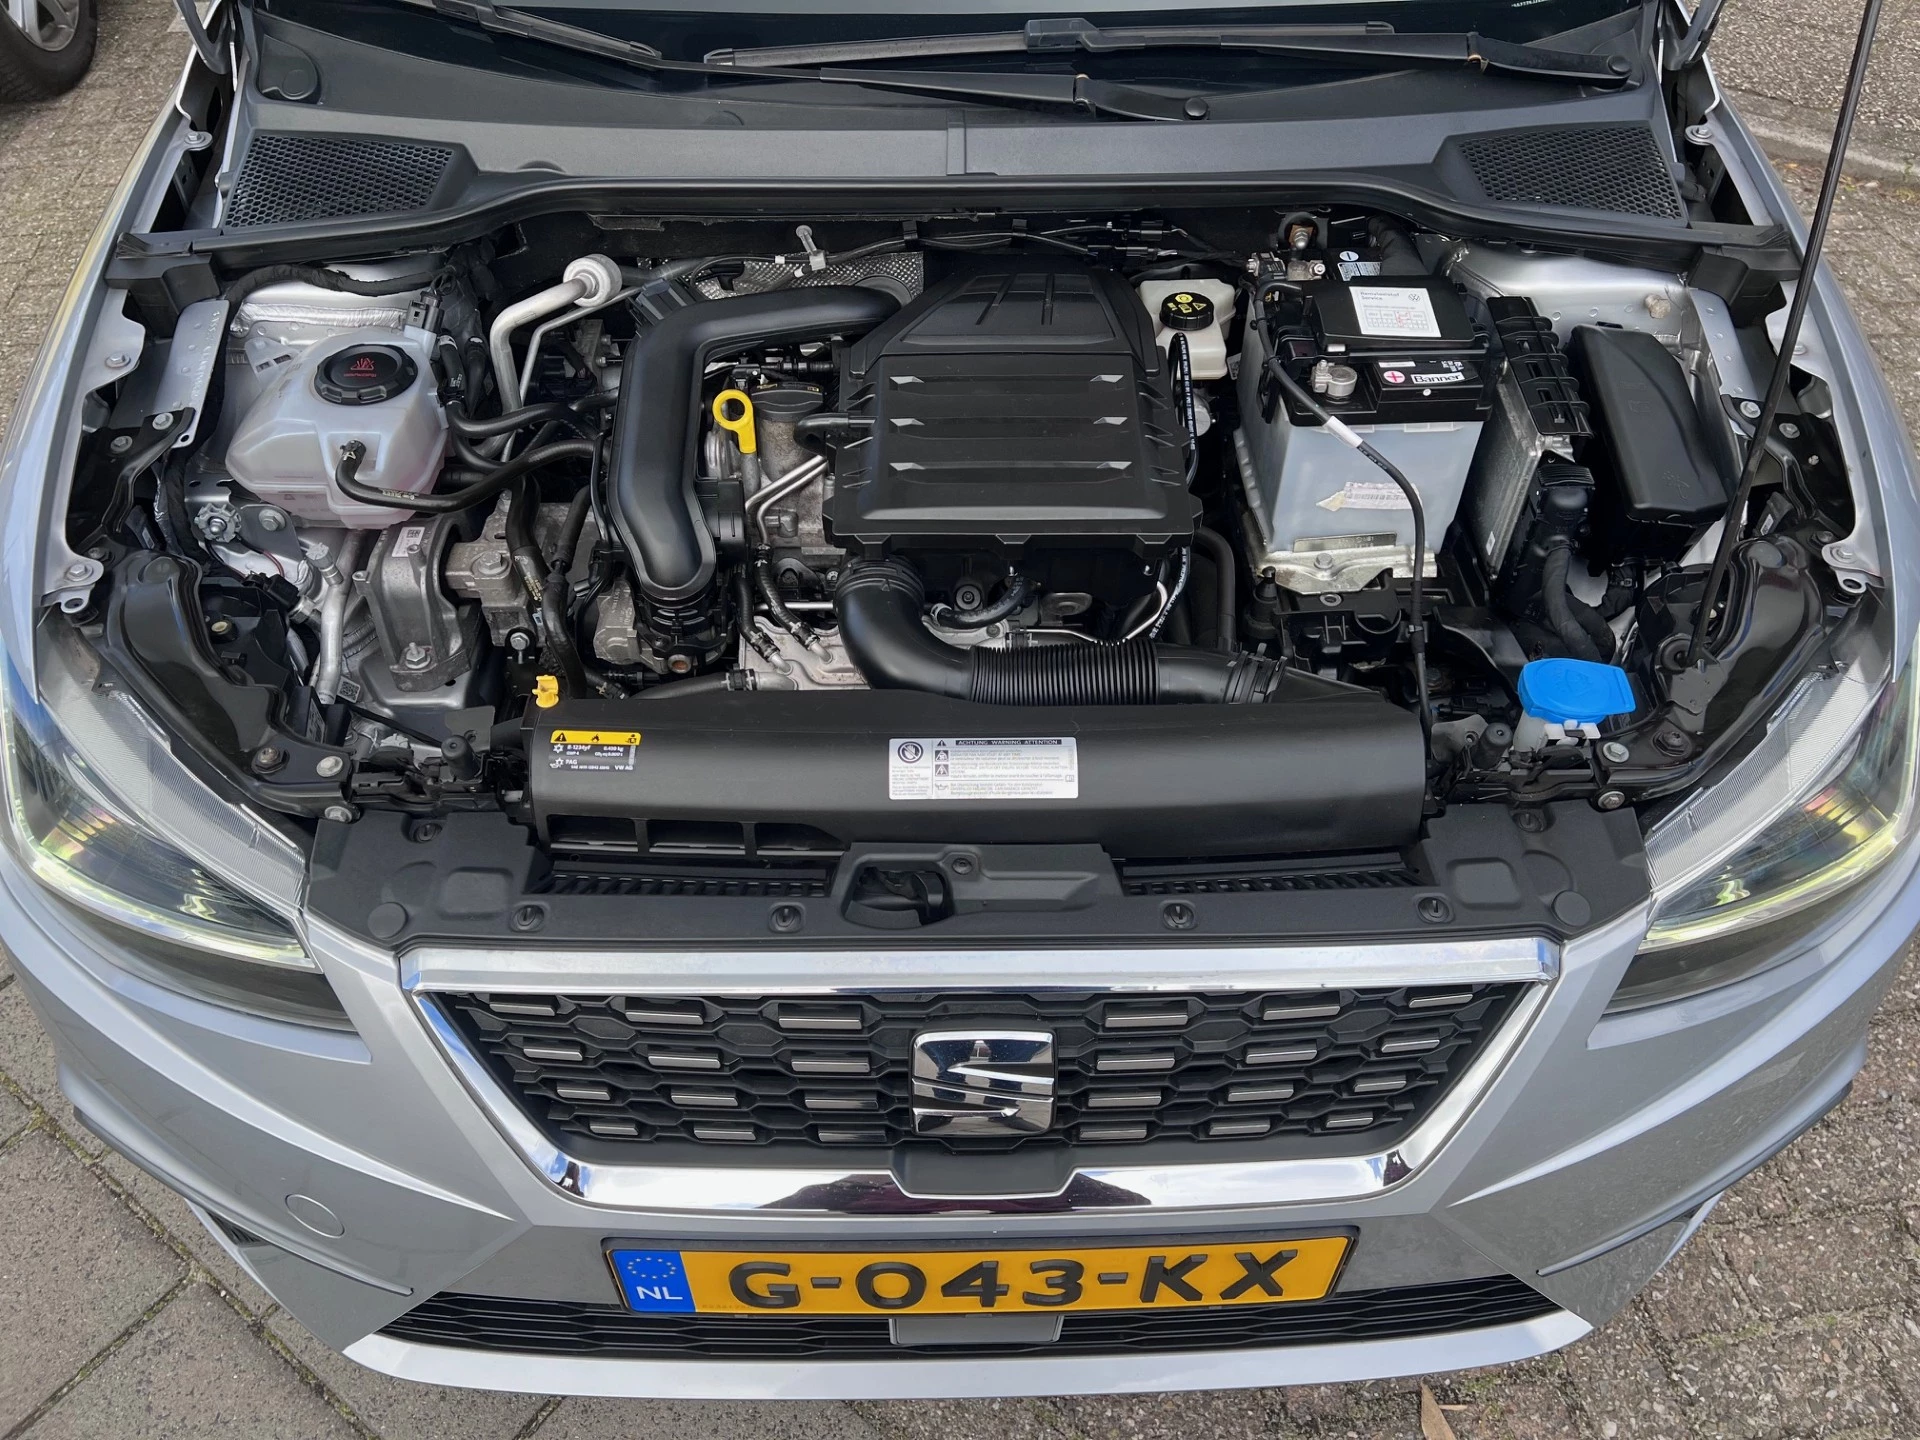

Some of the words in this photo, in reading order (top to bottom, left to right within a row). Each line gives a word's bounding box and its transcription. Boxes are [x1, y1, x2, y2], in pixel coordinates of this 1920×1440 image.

[1414, 374, 1461, 383] Banner
[728, 1249, 1298, 1309] G-043-KX
[636, 1286, 683, 1300] NL
